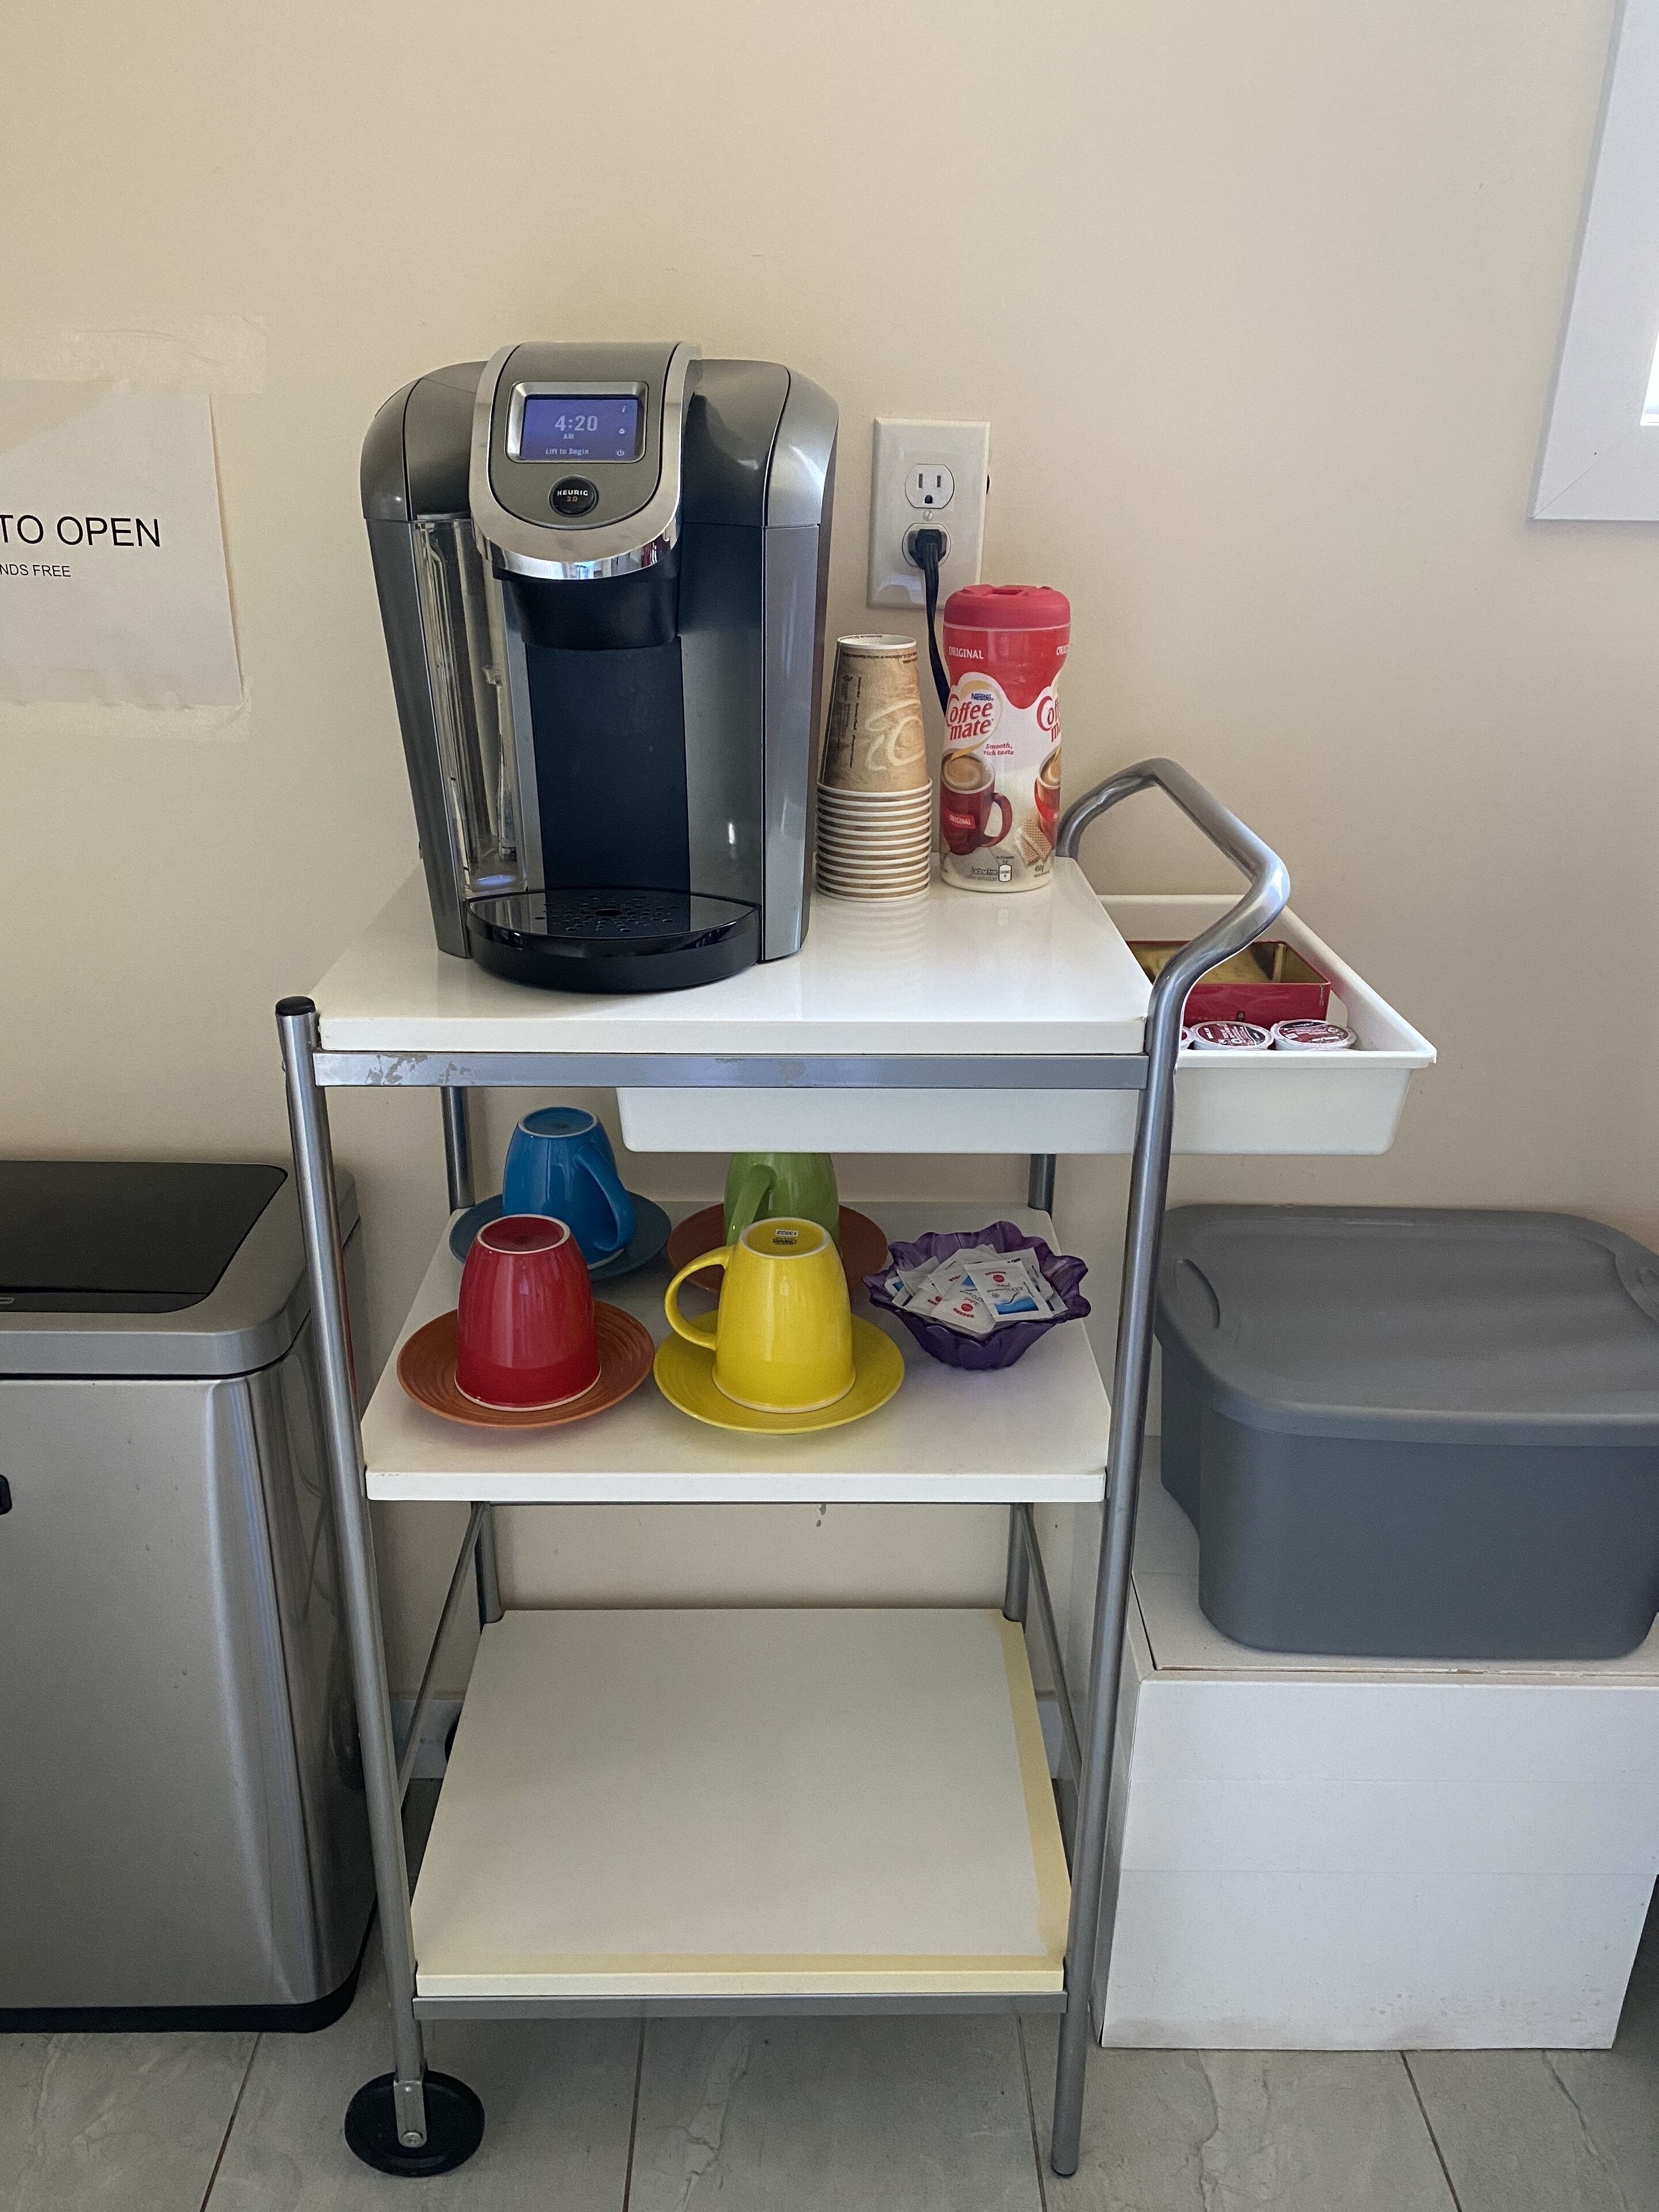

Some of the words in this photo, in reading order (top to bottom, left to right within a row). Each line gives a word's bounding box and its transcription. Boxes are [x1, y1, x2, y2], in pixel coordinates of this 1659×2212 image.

[555, 415, 598, 431] 4:20
[0, 514, 44, 544] TO
[56, 516, 161, 547] OPEN
[0, 564, 29, 575] NDS
[33, 565, 71, 577] FREE
[949, 646, 984, 660] ORIGINAL
[946, 694, 993, 727] Coffee
[950, 719, 991, 741] mate
[949, 814, 971, 825] ORIGINAL
